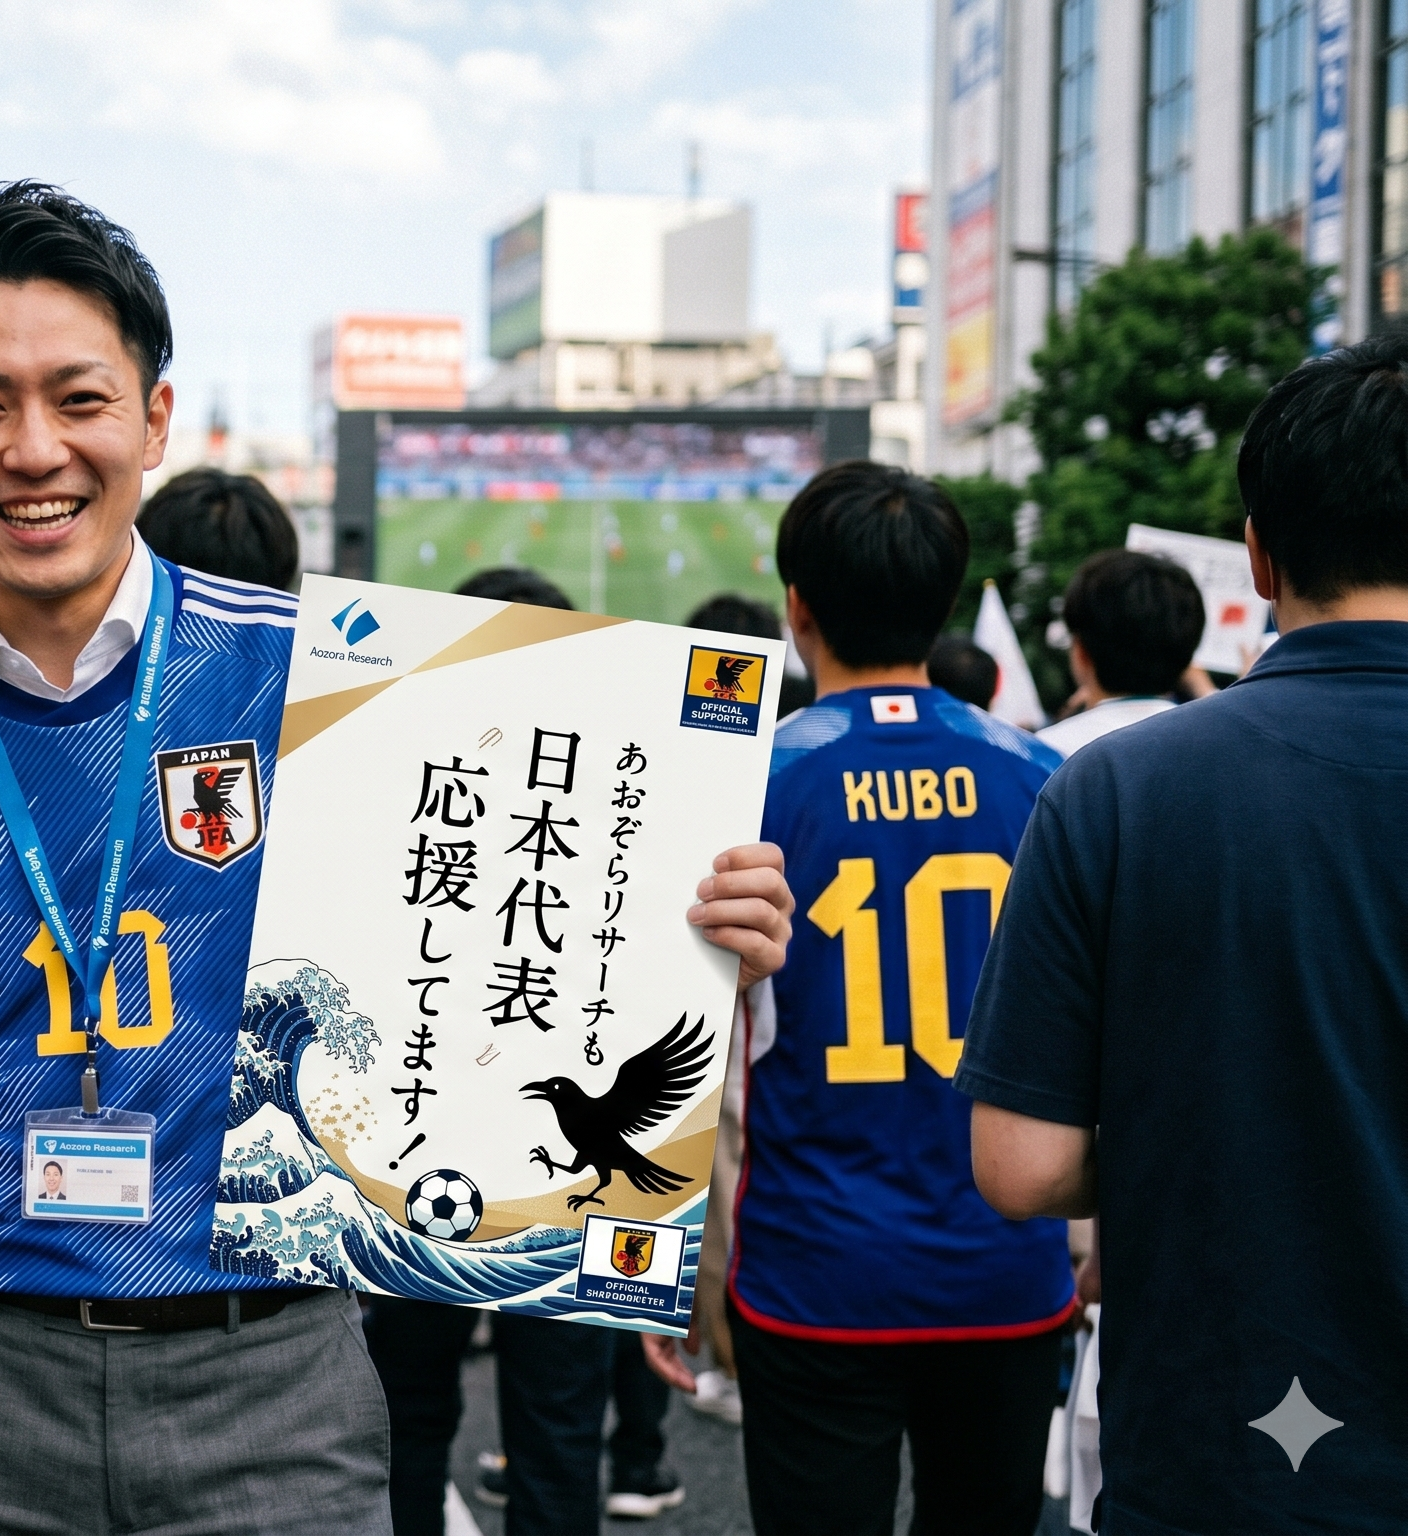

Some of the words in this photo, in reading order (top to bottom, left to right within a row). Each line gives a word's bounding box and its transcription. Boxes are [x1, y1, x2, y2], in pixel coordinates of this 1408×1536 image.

[309, 646, 345, 661] Aozora
[348, 651, 393, 667] Research
[691, 710, 749, 725] SUPPORTER
[701, 702, 743, 716] OFFICIAL
[181, 748, 231, 764] JAPAN
[843, 766, 978, 822] KUBO
[195, 827, 236, 849] JFA
[482, 726, 582, 1033] 日本代表
[582, 741, 648, 1066] あおぞらリサーチも
[806, 853, 1014, 1084] 10
[22, 909, 174, 1057] 10
[605, 1281, 649, 1295] OFFICIAL
